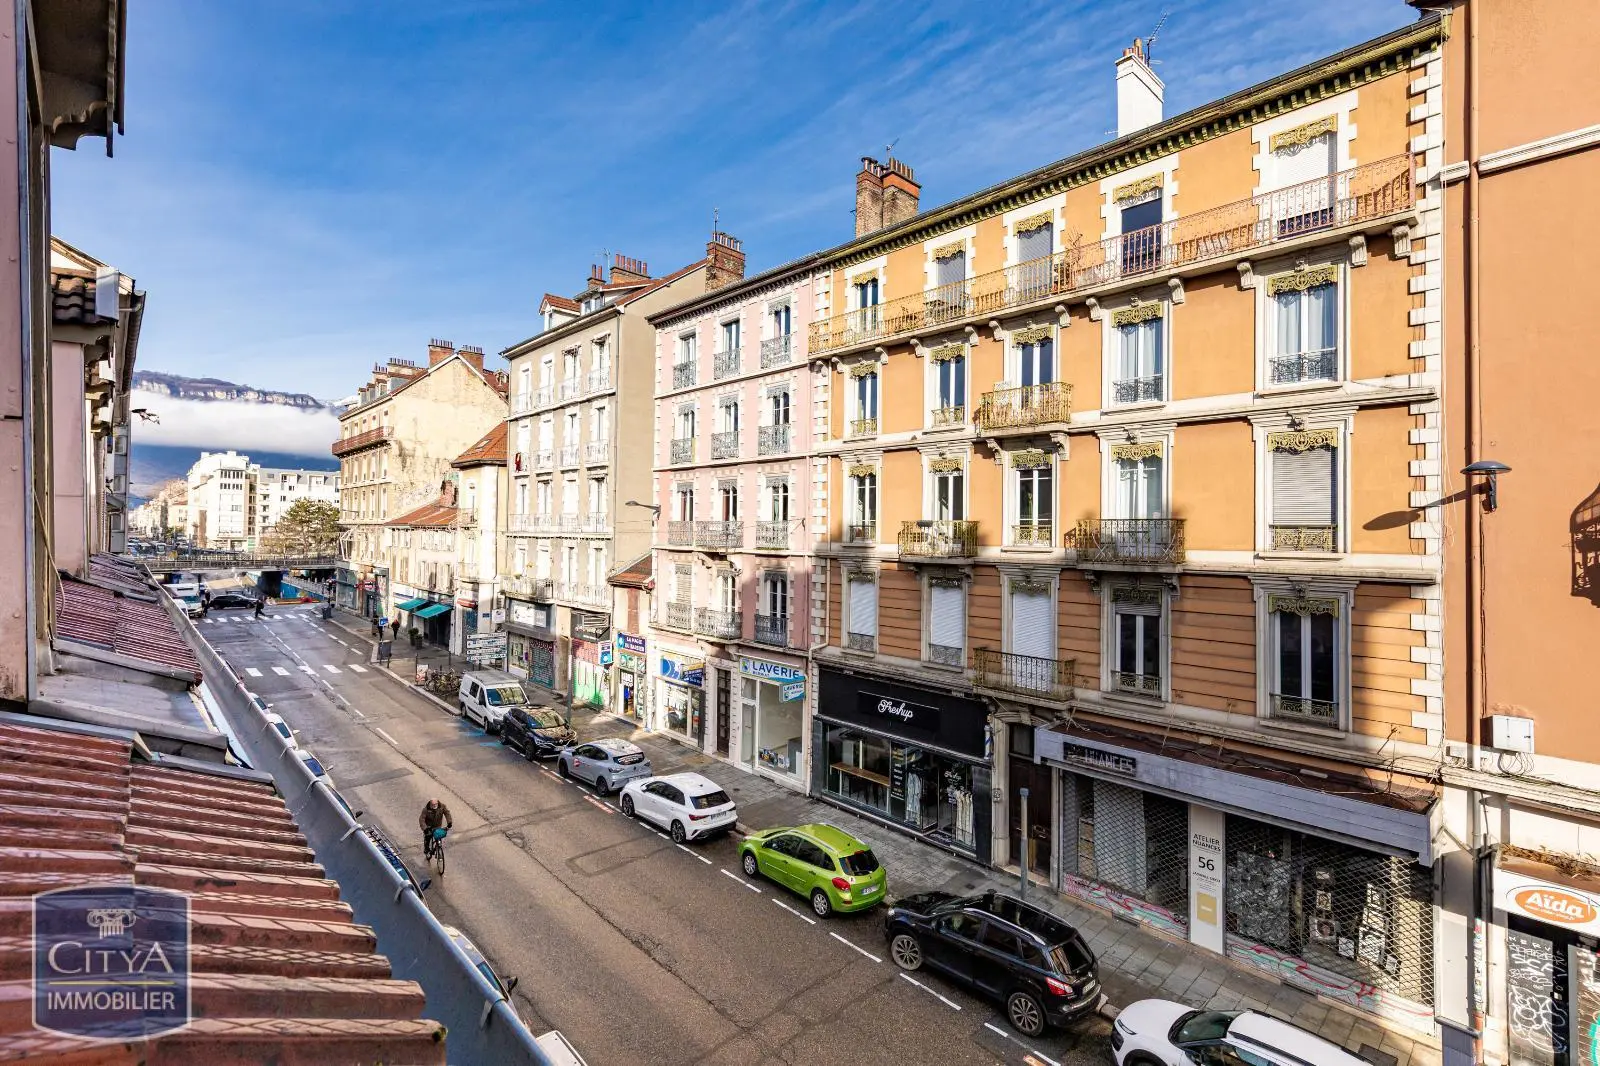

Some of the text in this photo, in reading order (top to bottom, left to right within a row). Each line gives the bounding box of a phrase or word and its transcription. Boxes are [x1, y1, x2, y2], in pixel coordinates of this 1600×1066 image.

[752, 661, 799, 679] LAVERIE
[878, 699, 913, 722] Freshup
[1192, 839, 1221, 852] NUANCES
[1193, 833, 1220, 846] ATELIER
[1198, 856, 1215, 871] 56
[1525, 892, 1585, 918] Aïda
